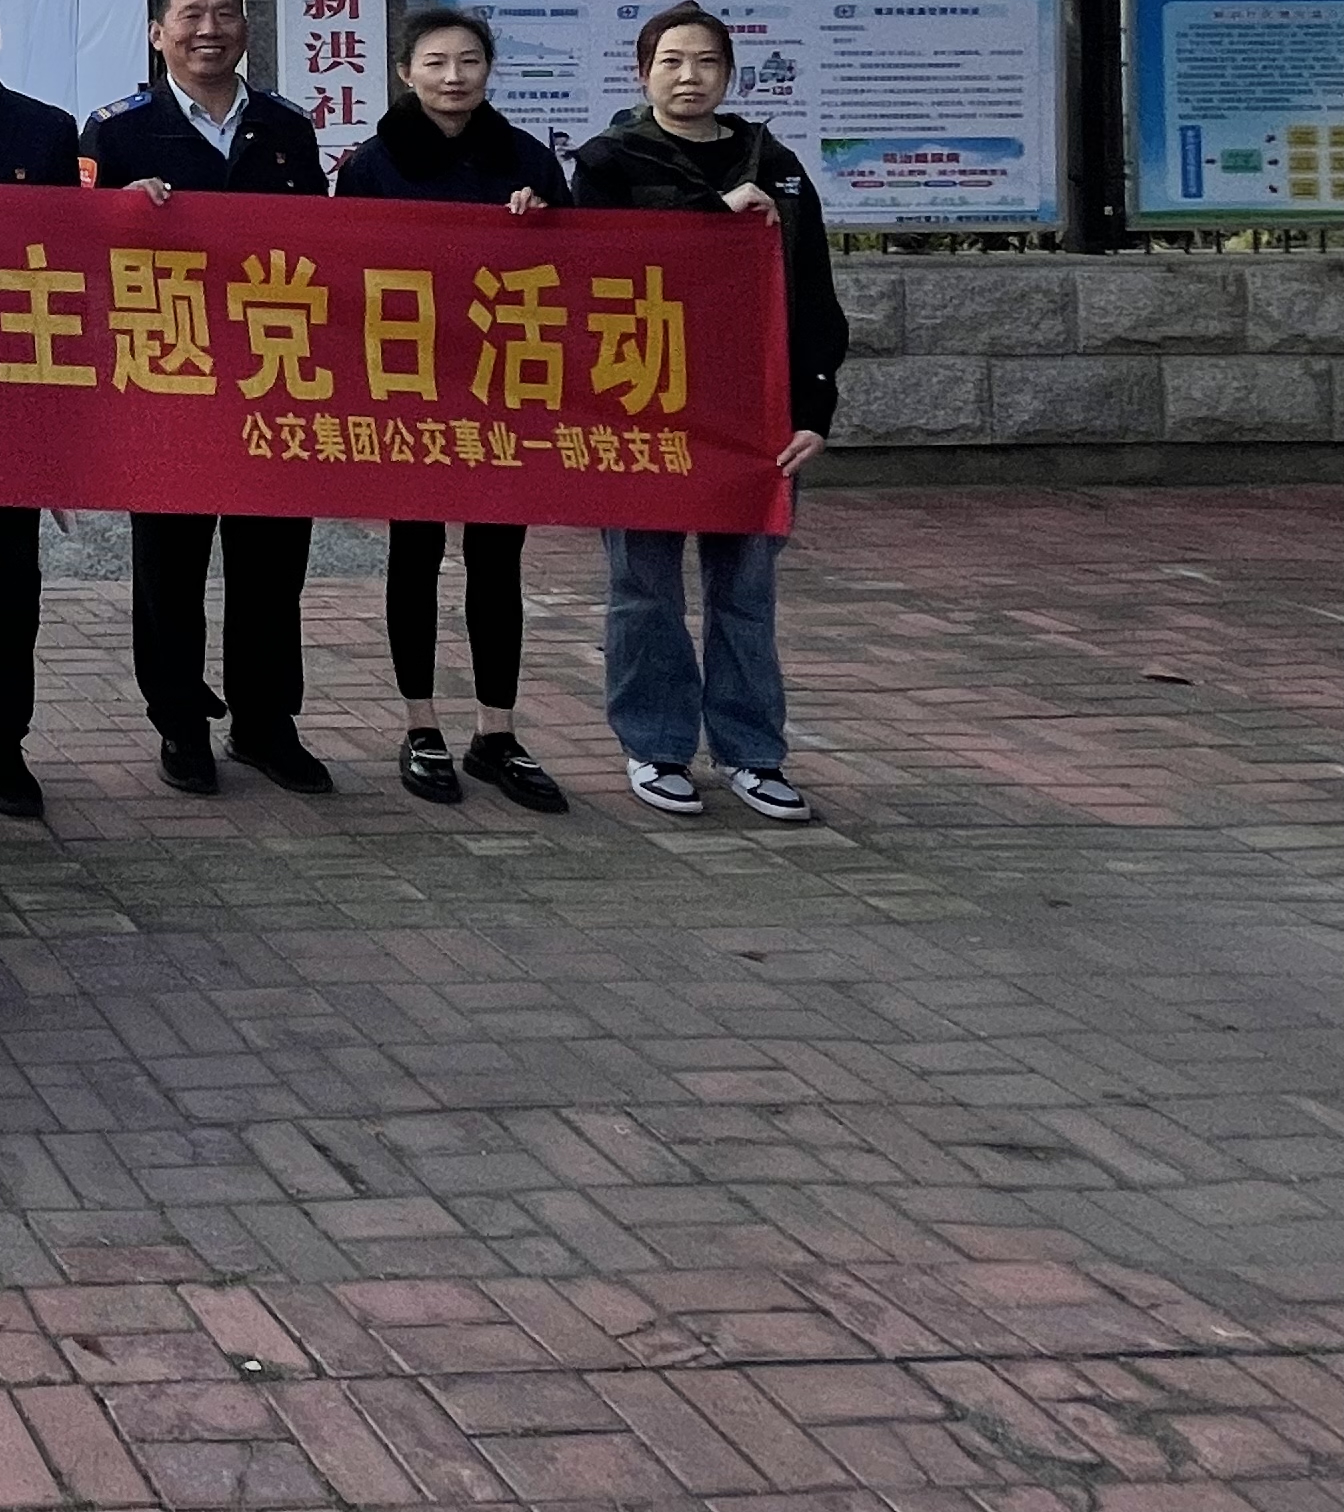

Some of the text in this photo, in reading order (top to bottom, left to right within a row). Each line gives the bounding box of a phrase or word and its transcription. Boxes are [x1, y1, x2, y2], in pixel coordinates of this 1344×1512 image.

[241, 411, 694, 477] 公交集团公交事业一部党支部
